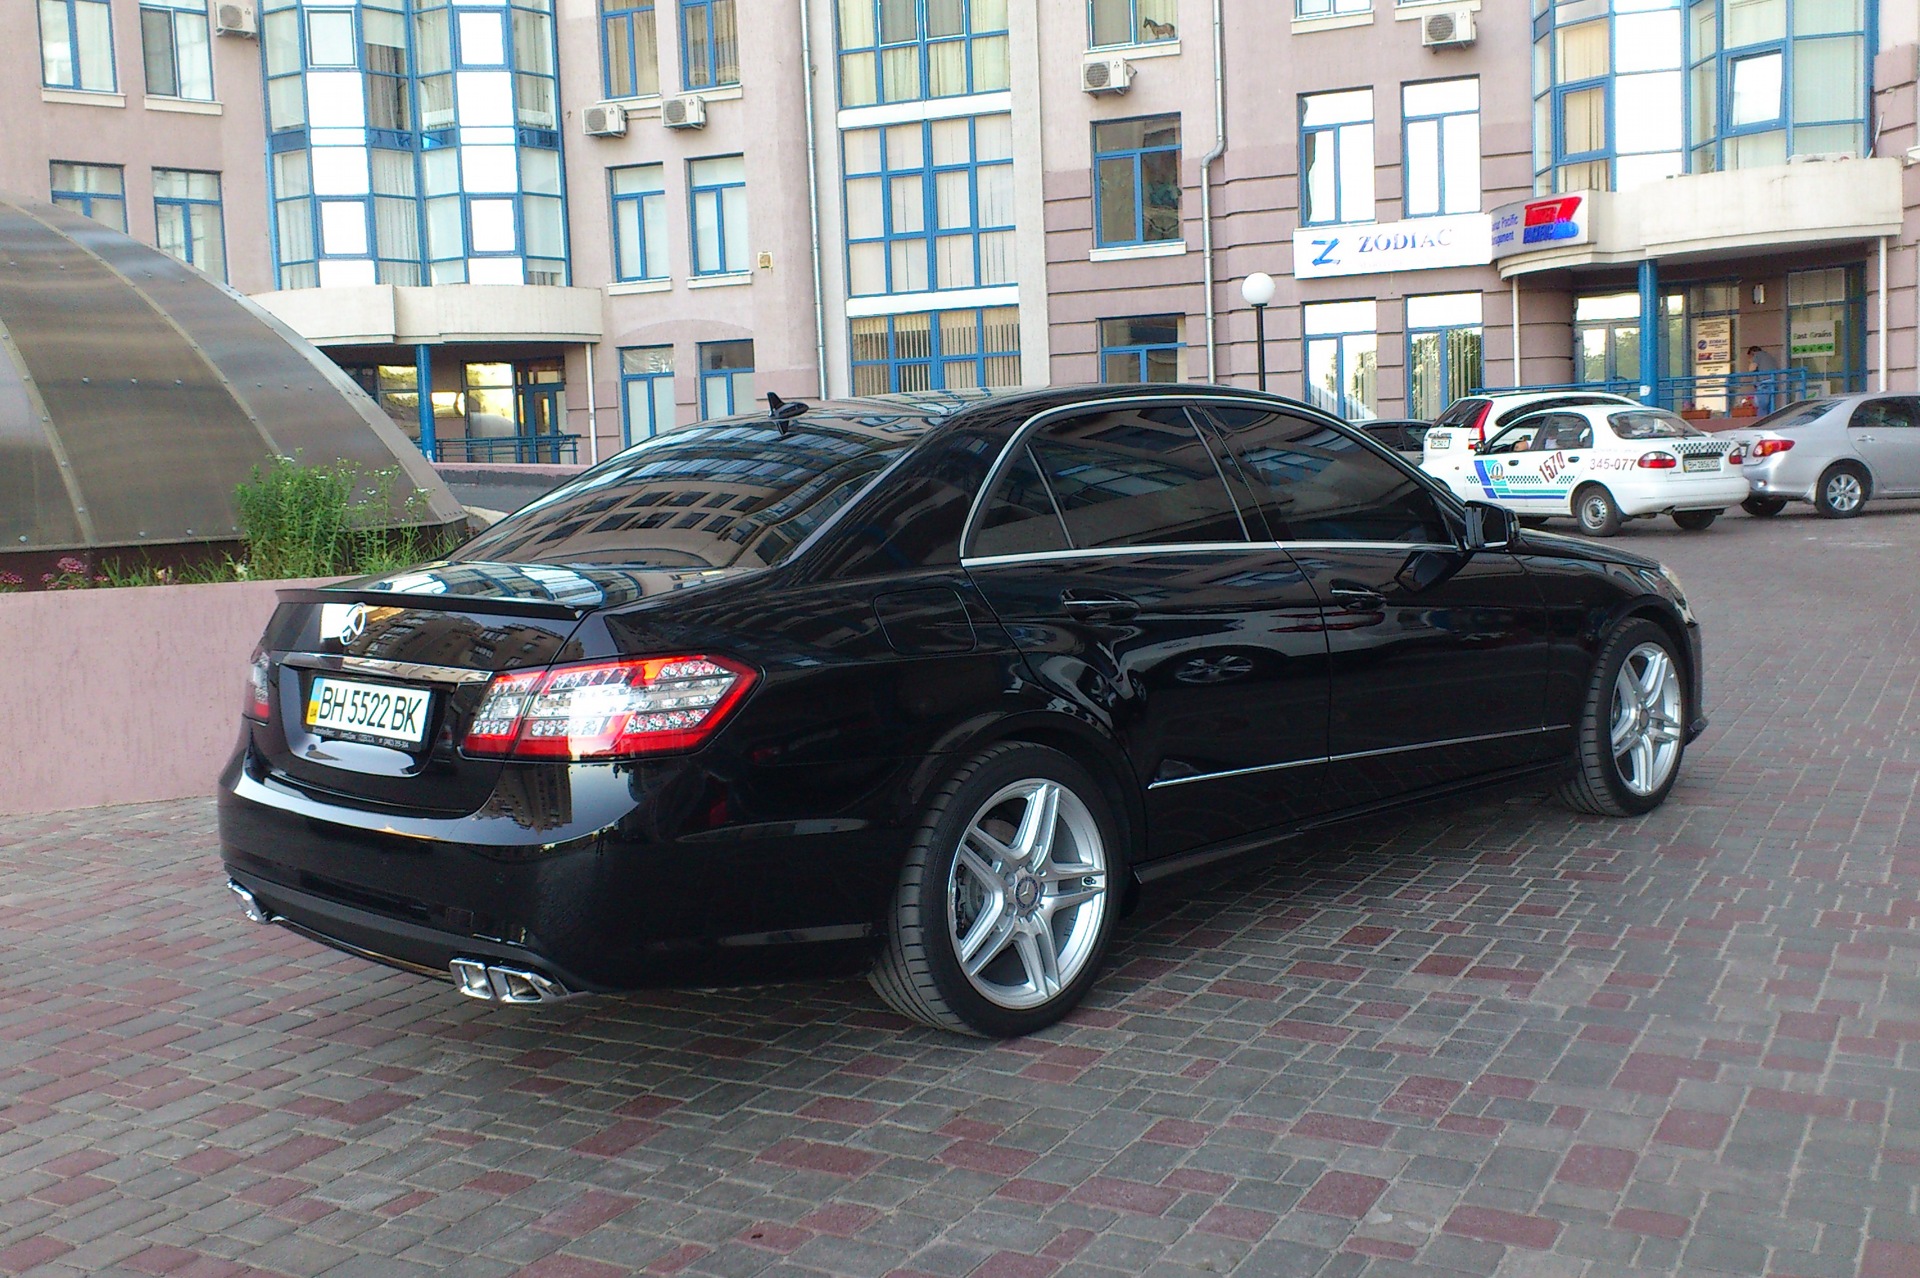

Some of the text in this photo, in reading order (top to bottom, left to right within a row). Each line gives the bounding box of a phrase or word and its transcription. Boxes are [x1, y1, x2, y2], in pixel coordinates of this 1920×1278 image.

[1358, 228, 1452, 253] ZODIAC
[1539, 451, 1566, 483] 1570
[1590, 458, 1636, 471] 345-077
[318, 686, 423, 734] BH 5522 BK
